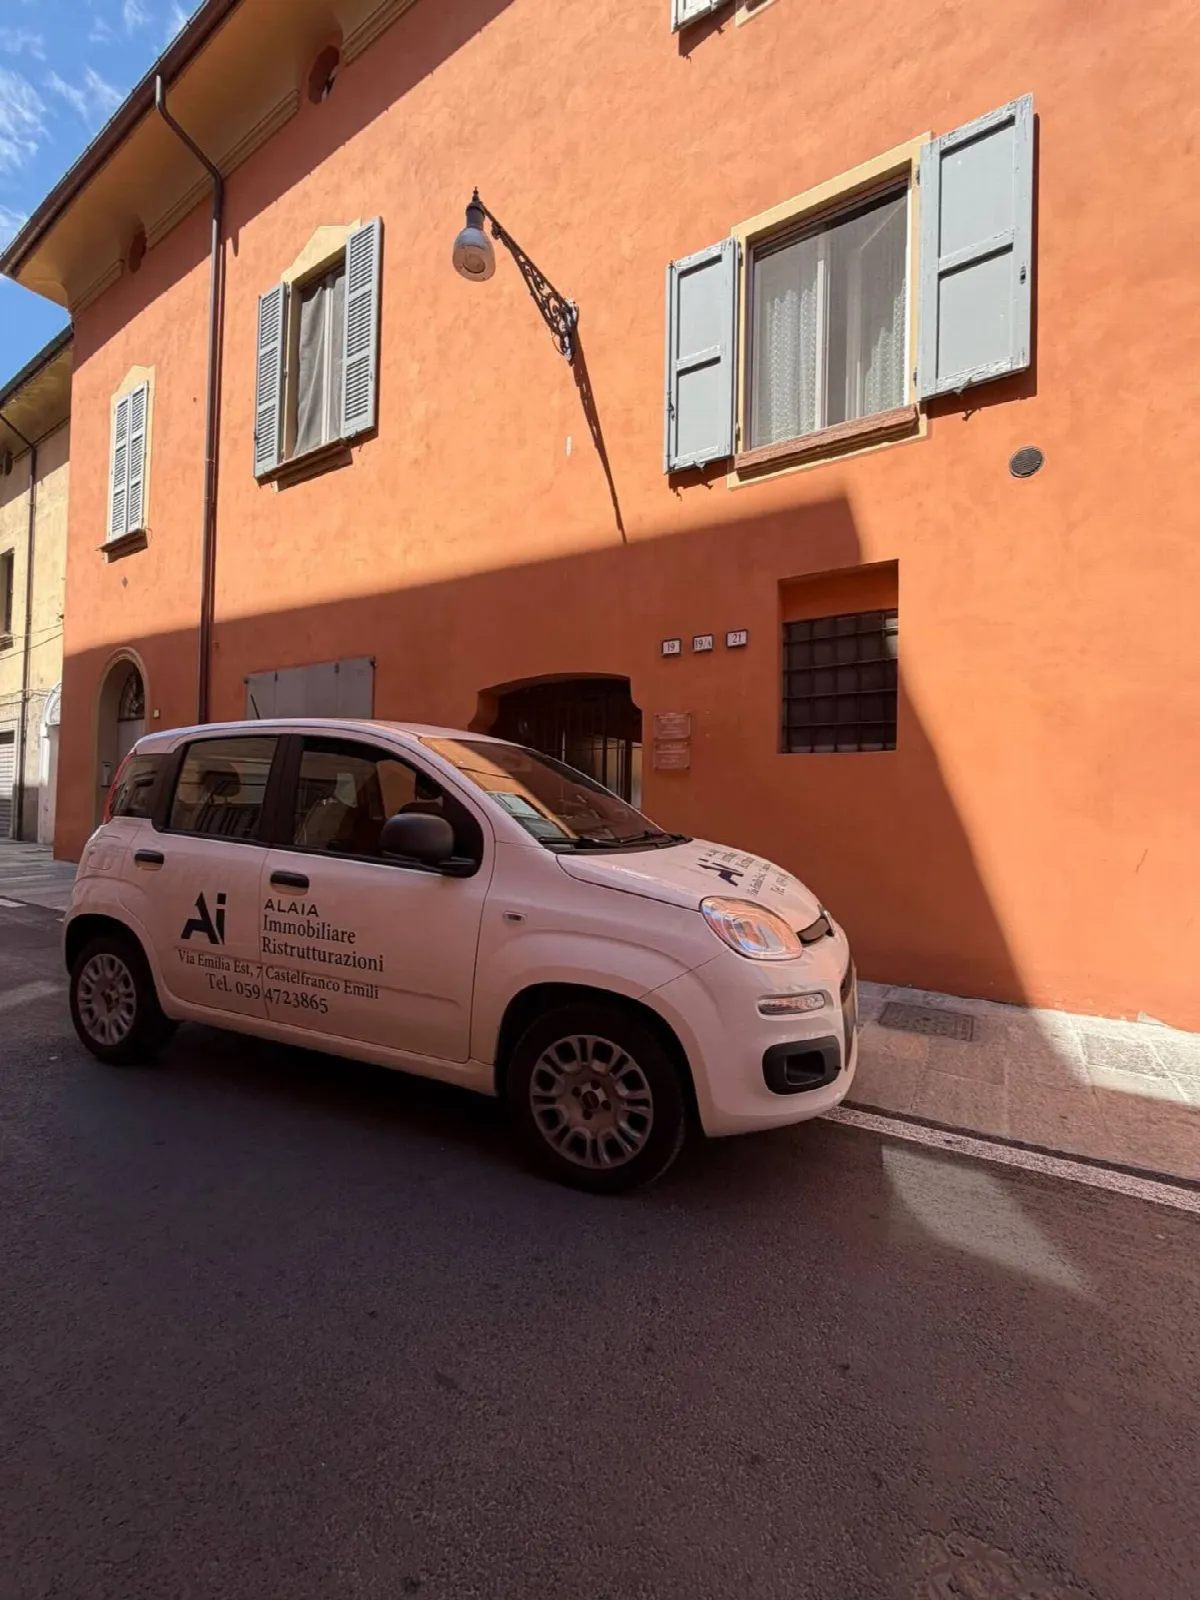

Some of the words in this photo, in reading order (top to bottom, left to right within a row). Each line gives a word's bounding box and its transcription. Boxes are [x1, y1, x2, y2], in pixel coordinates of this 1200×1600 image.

[732, 633, 742, 644] 21
[264, 898, 319, 917] ALAIA
[263, 914, 356, 945] Immobiliare
[262, 936, 384, 973] Ristrutturazioni
[178, 949, 195, 965] Via
[198, 953, 231, 972] Emilia
[234, 960, 254, 978] Est,
[256, 966, 263, 979] 7
[265, 966, 340, 992] Castelfranco
[344, 979, 379, 1000] Emili
[206, 973, 232, 992] Tel.
[235, 981, 261, 1000] 059
[263, 988, 329, 1014] 4723865
